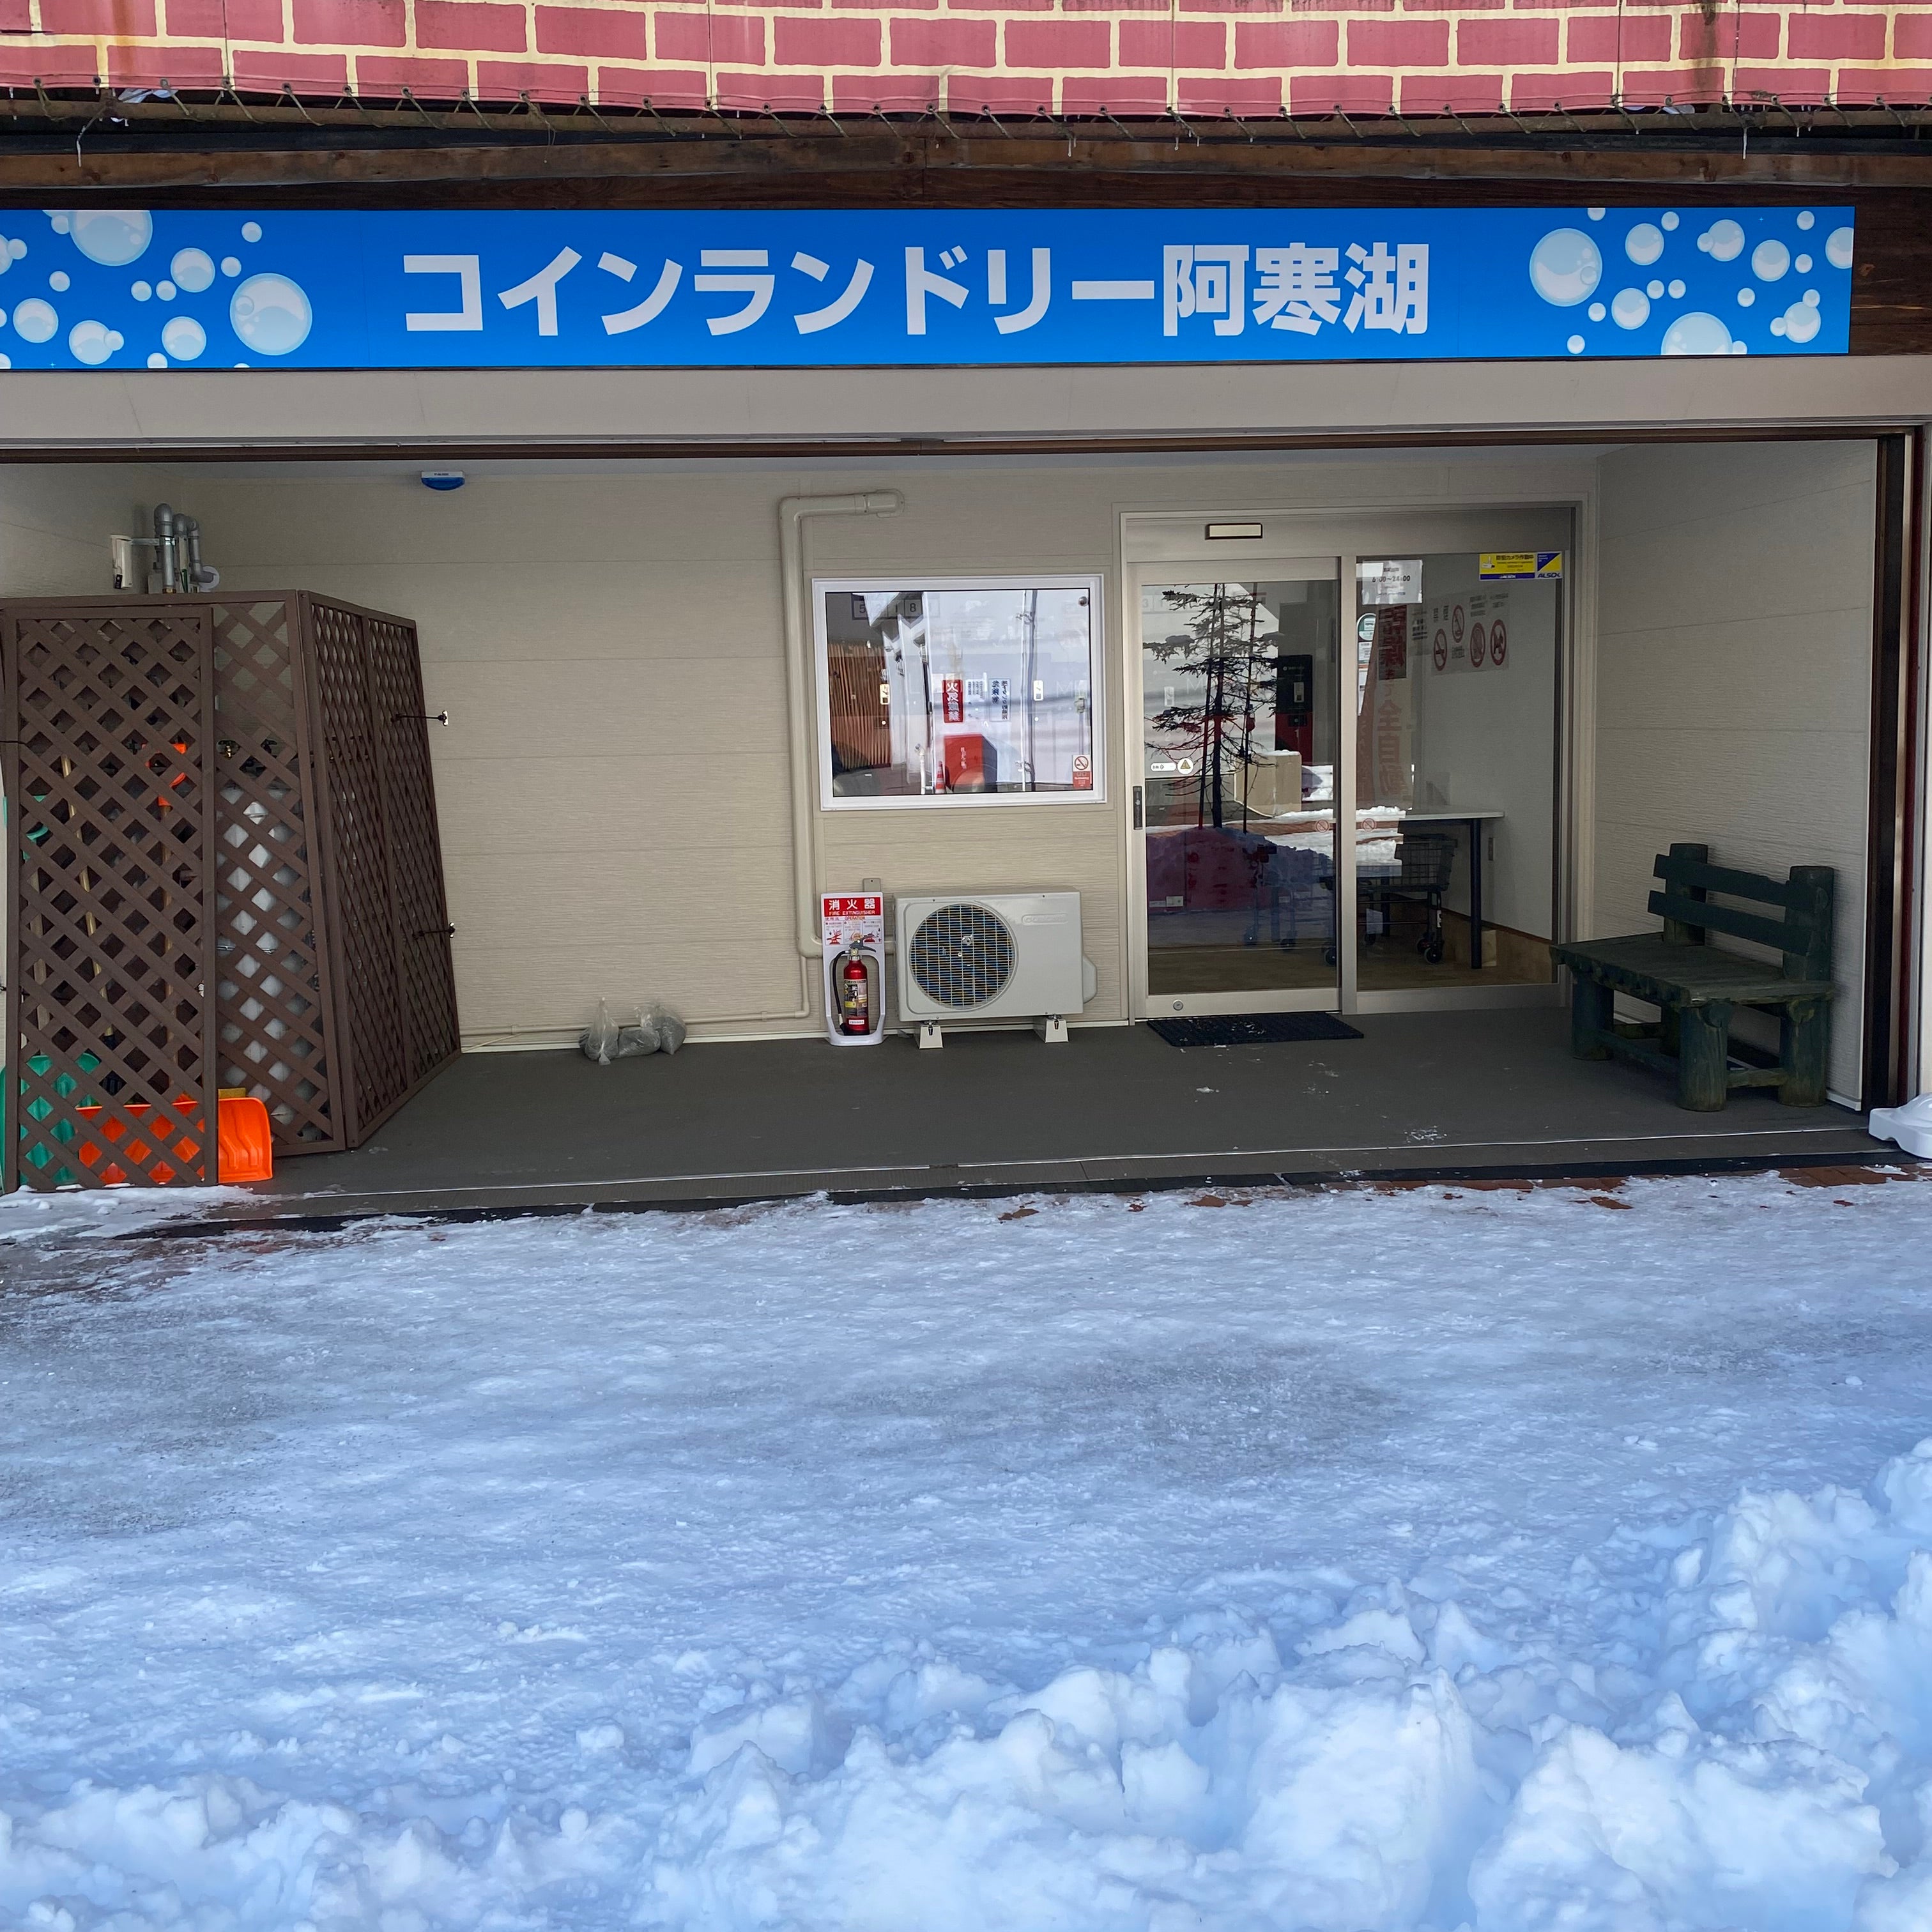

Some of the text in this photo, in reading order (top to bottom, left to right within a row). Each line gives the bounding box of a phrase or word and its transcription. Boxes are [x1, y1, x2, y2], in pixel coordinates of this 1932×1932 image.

[403, 243, 1429, 337] コインランドリー阿寒湖
[828, 898, 875, 911] 消火器
